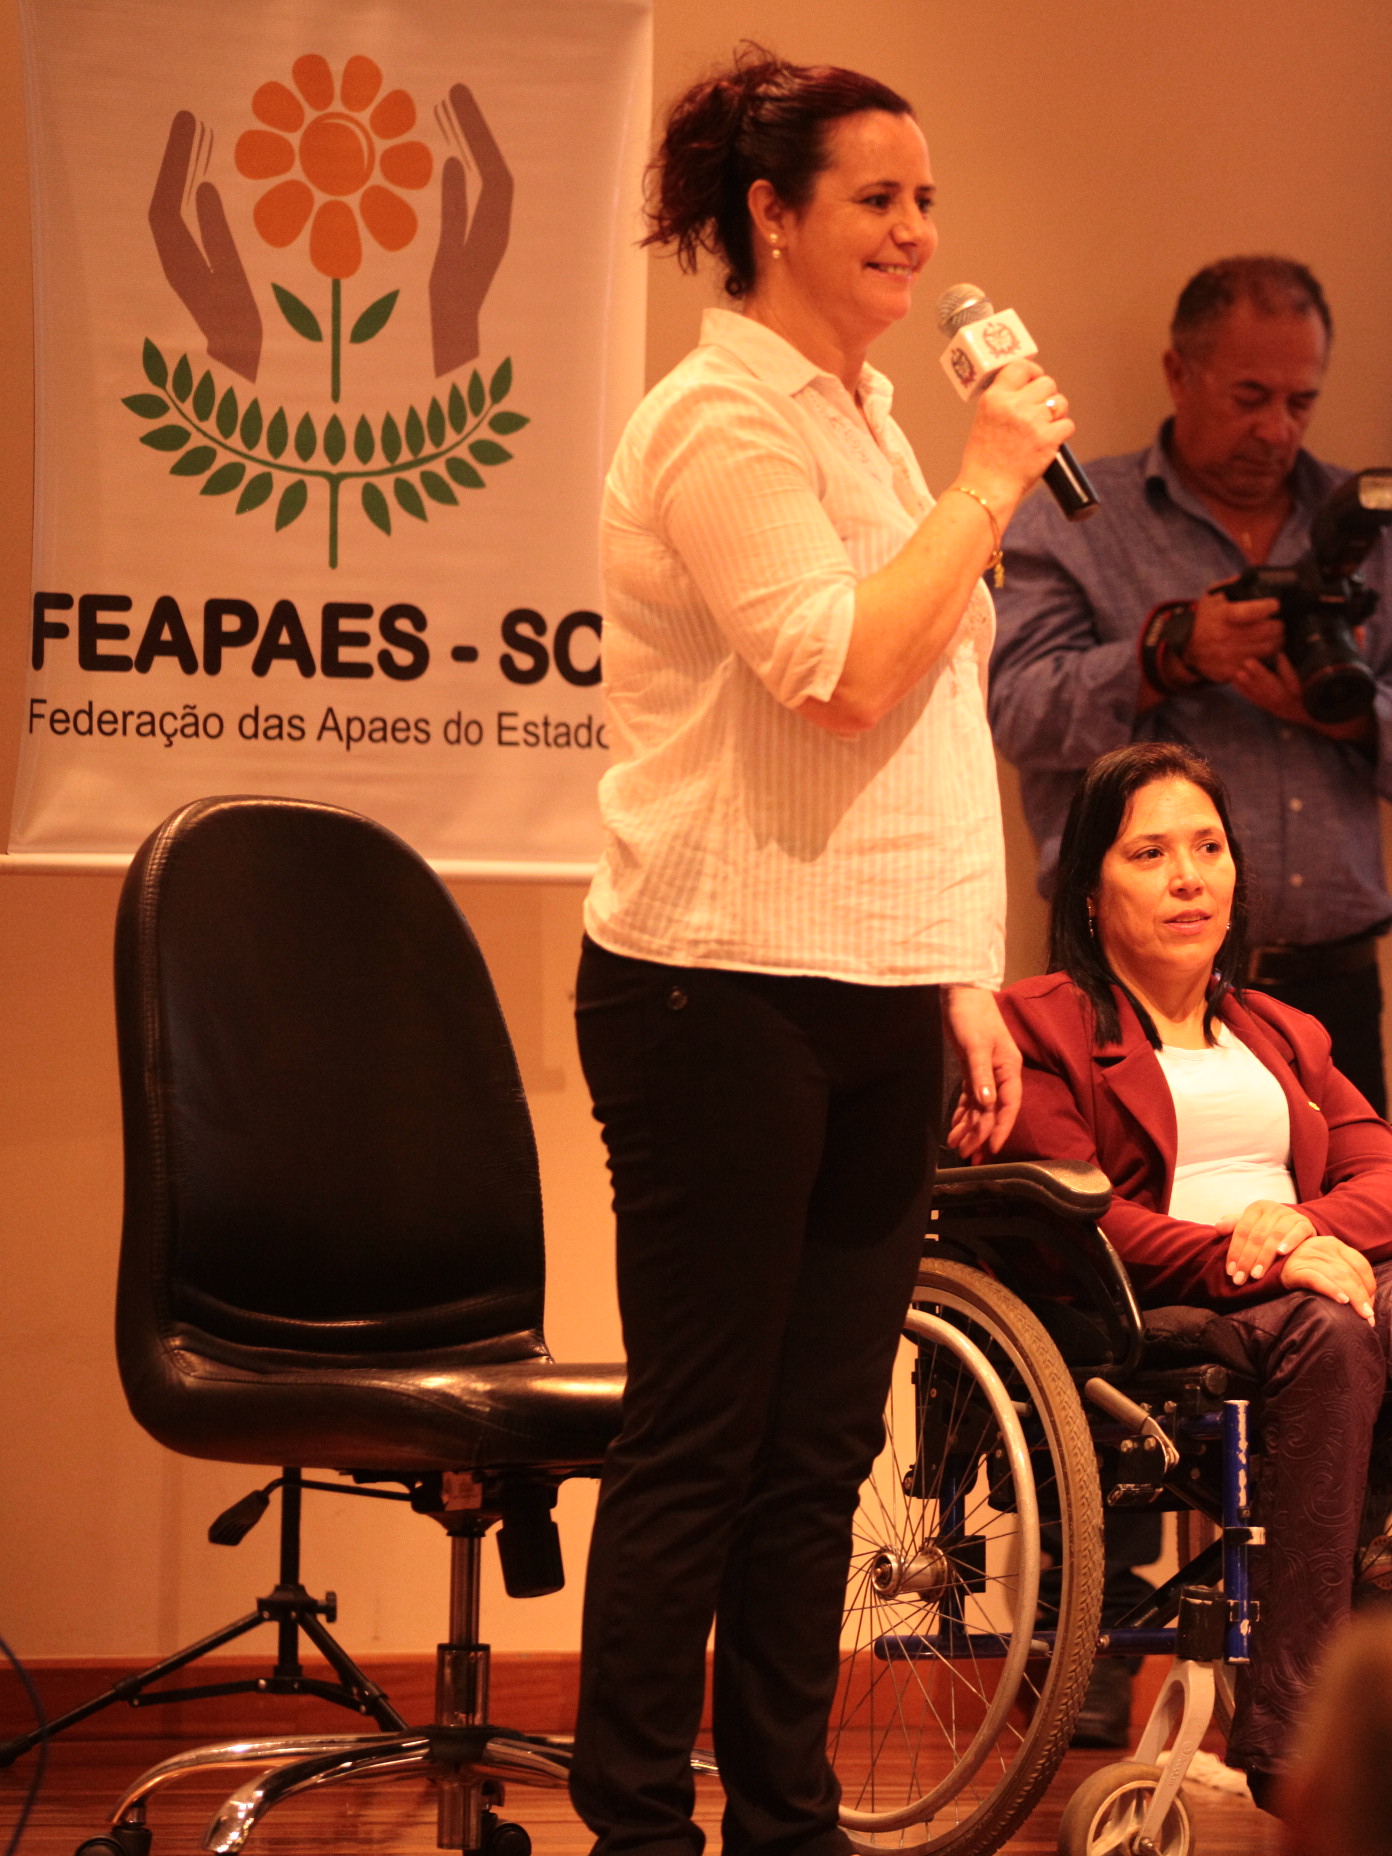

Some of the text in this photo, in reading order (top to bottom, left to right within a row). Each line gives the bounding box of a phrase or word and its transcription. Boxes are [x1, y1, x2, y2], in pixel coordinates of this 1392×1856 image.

[31, 591, 603, 688] FEAPAES - SC
[28, 697, 224, 748] Federação
[237, 705, 306, 742] das
[316, 706, 431, 752] Apaes
[443, 710, 484, 746] do
